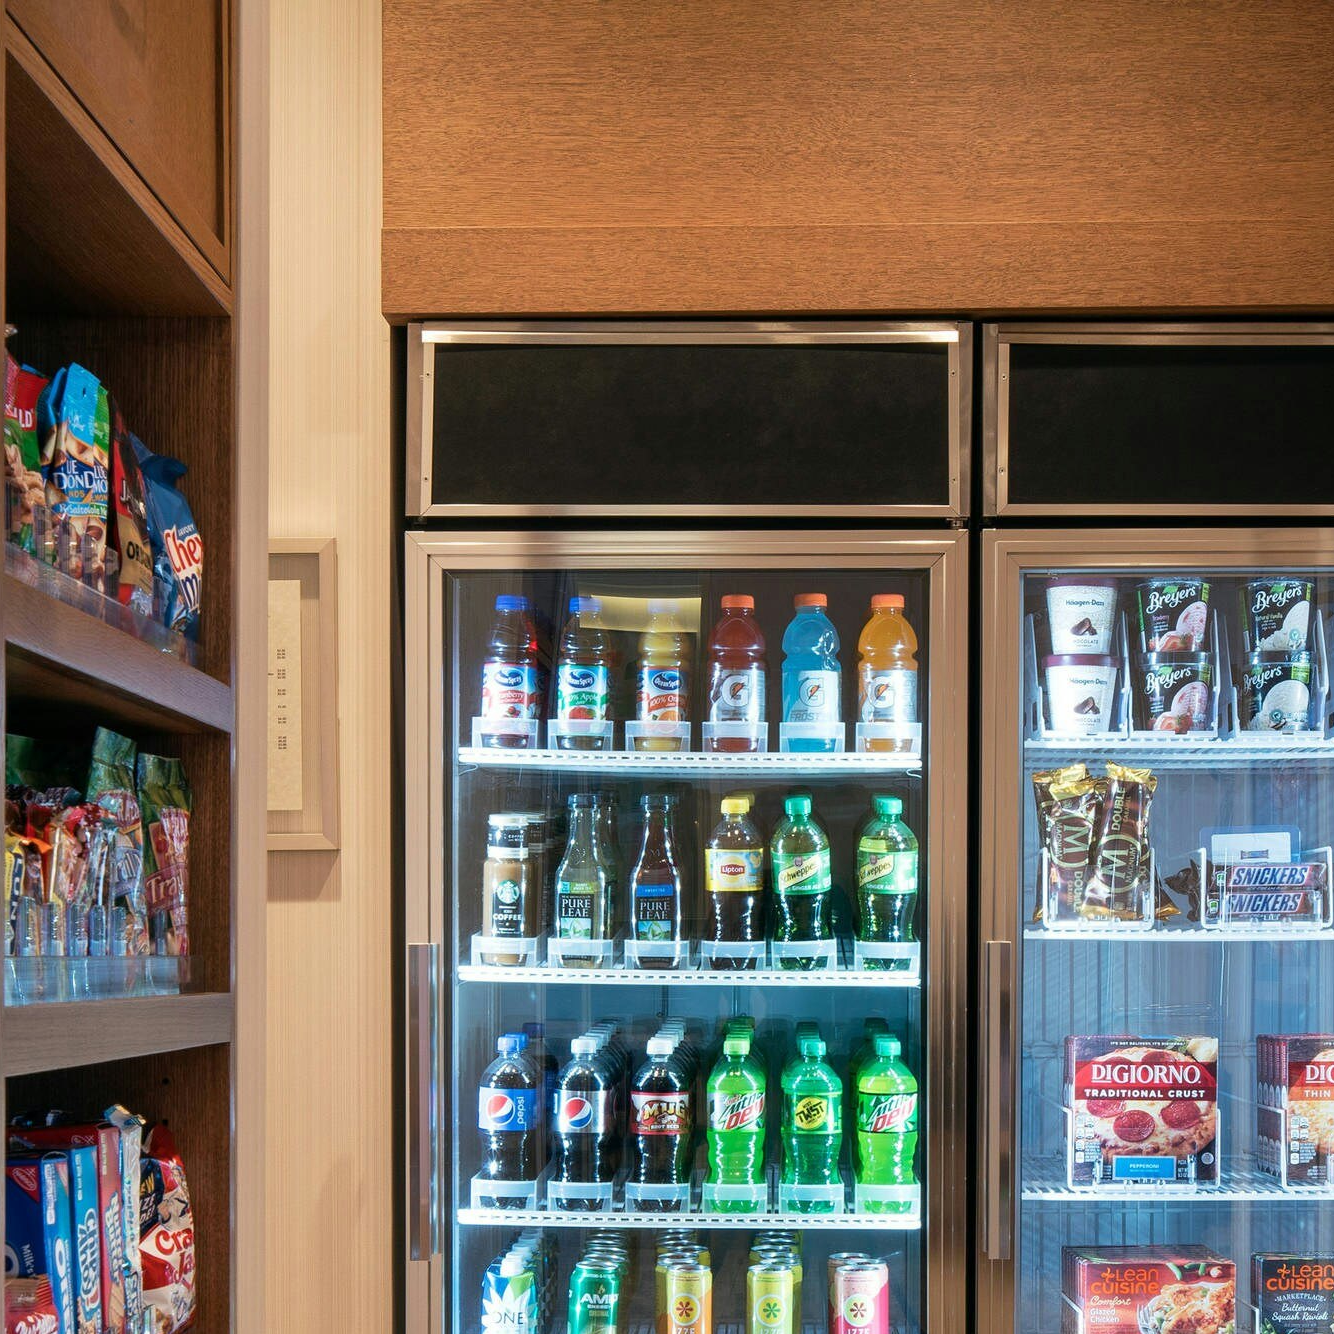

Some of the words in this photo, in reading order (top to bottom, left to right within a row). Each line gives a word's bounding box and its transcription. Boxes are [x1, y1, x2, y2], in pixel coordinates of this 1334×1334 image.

[1146, 585, 1196, 614] Breyers
[1252, 586, 1303, 613] Breyers
[1144, 667, 1192, 695] Breyers
[1244, 666, 1283, 694] Breyers
[721, 675, 750, 707] G
[799, 677, 825, 707] G
[868, 676, 895, 708] G
[1112, 786, 1126, 831] DOUBLE
[721, 864, 744, 875] Lipton
[1126, 844, 1137, 883] MAGNUM
[1232, 866, 1308, 886] SNICKERS
[562, 899, 591, 909] PURE
[640, 901, 670, 911] PURE
[493, 913, 522, 921] COFFEE
[562, 908, 590, 917] LEAF
[1084, 1089, 1163, 1098] TRADITIONAL
[1168, 1089, 1206, 1098] CRUST
[1304, 1089, 1331, 1097] THIN
[517, 1096, 527, 1126] pepsi
[644, 1100, 686, 1121] MUG
[1090, 1281, 1159, 1295] cuisine
[1266, 1277, 1334, 1291] cuisine
[1090, 1296, 1131, 1307] Comfort
[1276, 1292, 1325, 1302] MARKETPLACE
[1281, 1303, 1318, 1312] Butternut
[492, 1311, 524, 1325] ONE
[1272, 1312, 1300, 1322] Squash
[1302, 1312, 1329, 1321] Ravioli
